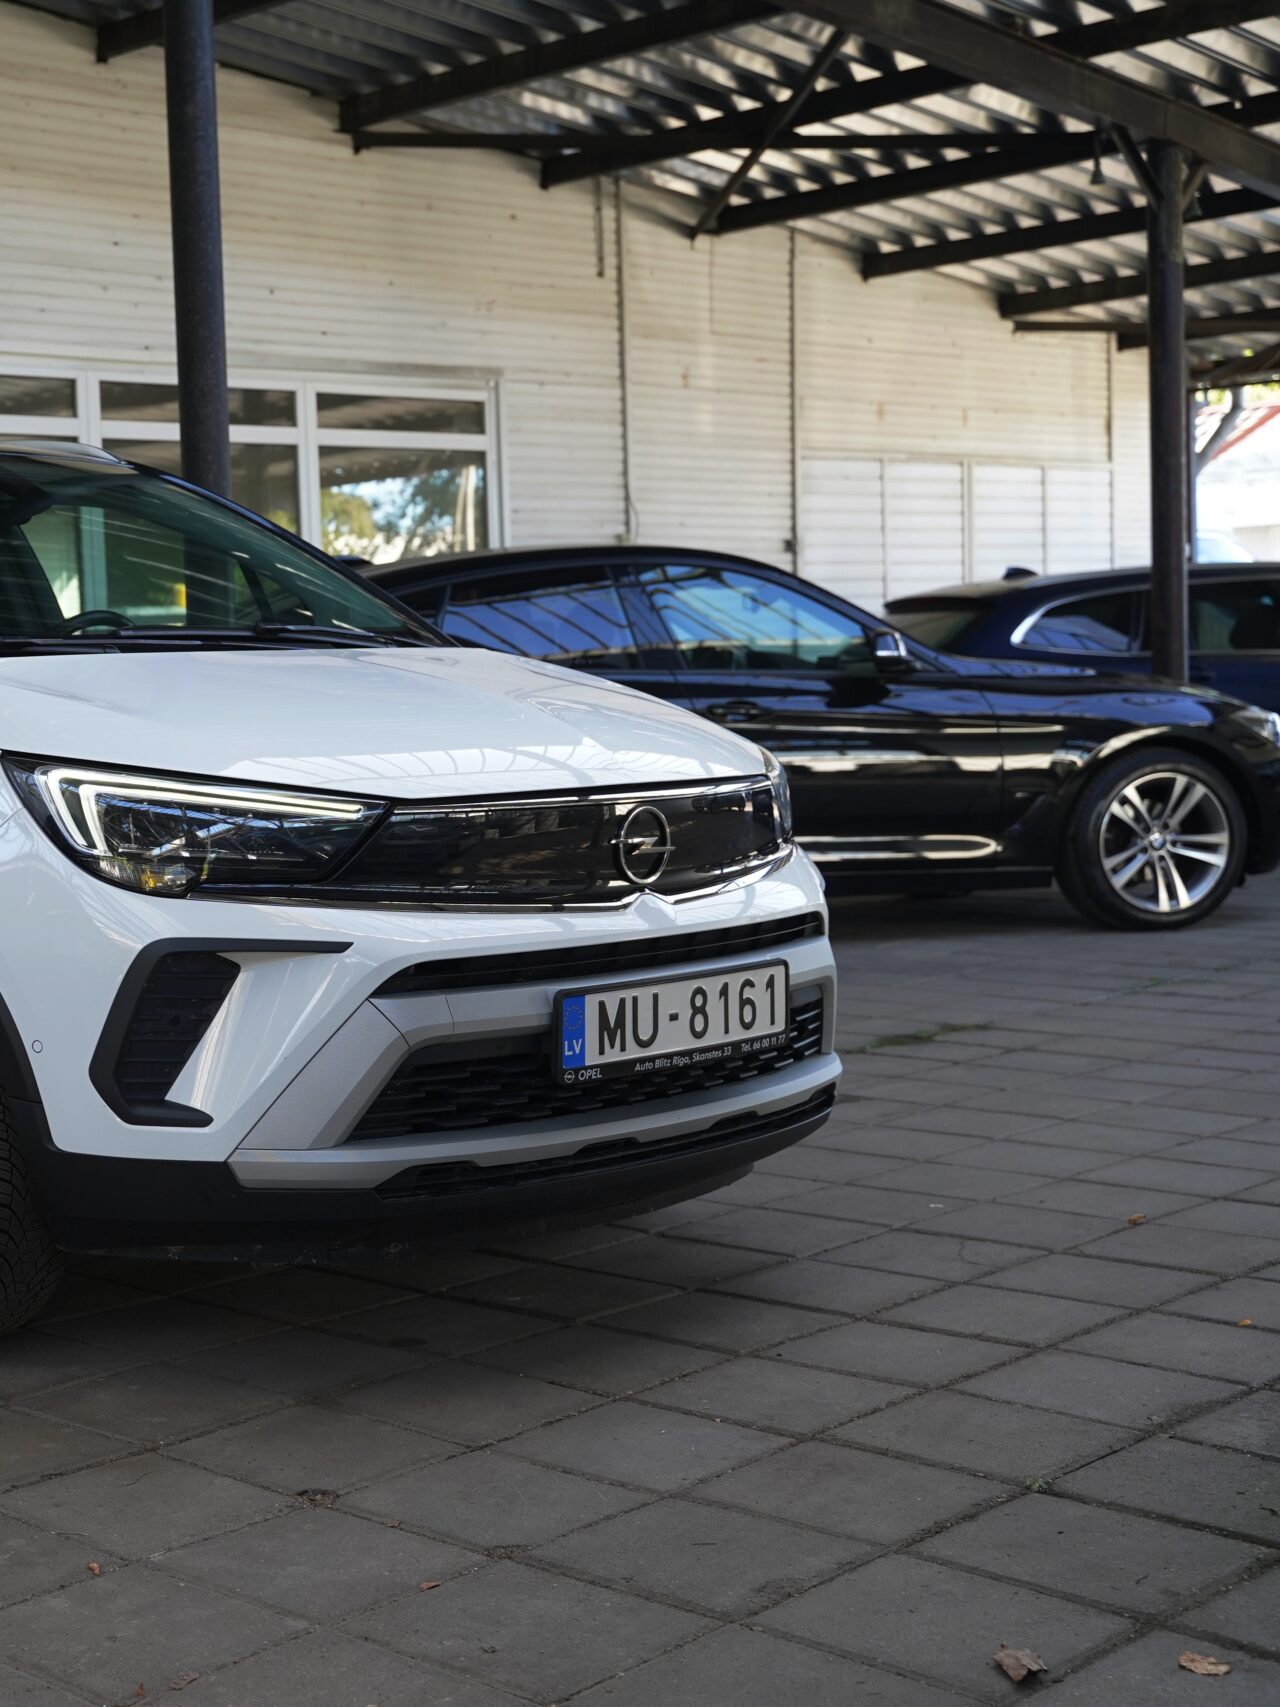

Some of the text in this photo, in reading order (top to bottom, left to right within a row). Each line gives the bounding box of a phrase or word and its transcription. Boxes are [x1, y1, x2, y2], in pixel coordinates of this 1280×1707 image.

[597, 973, 776, 1056] MU-8161
[565, 1039, 582, 1056] LV
[741, 1041, 752, 1053] Tel.
[752, 1040, 760, 1050] 66
[761, 1038, 770, 1047] 00
[778, 1034, 786, 1044] 77
[634, 1062, 653, 1072] Auto
[654, 1058, 671, 1069] Blitz
[692, 1049, 722, 1062] Skanstes
[723, 1046, 732, 1056] 33
[578, 1067, 603, 1081] OPEL
